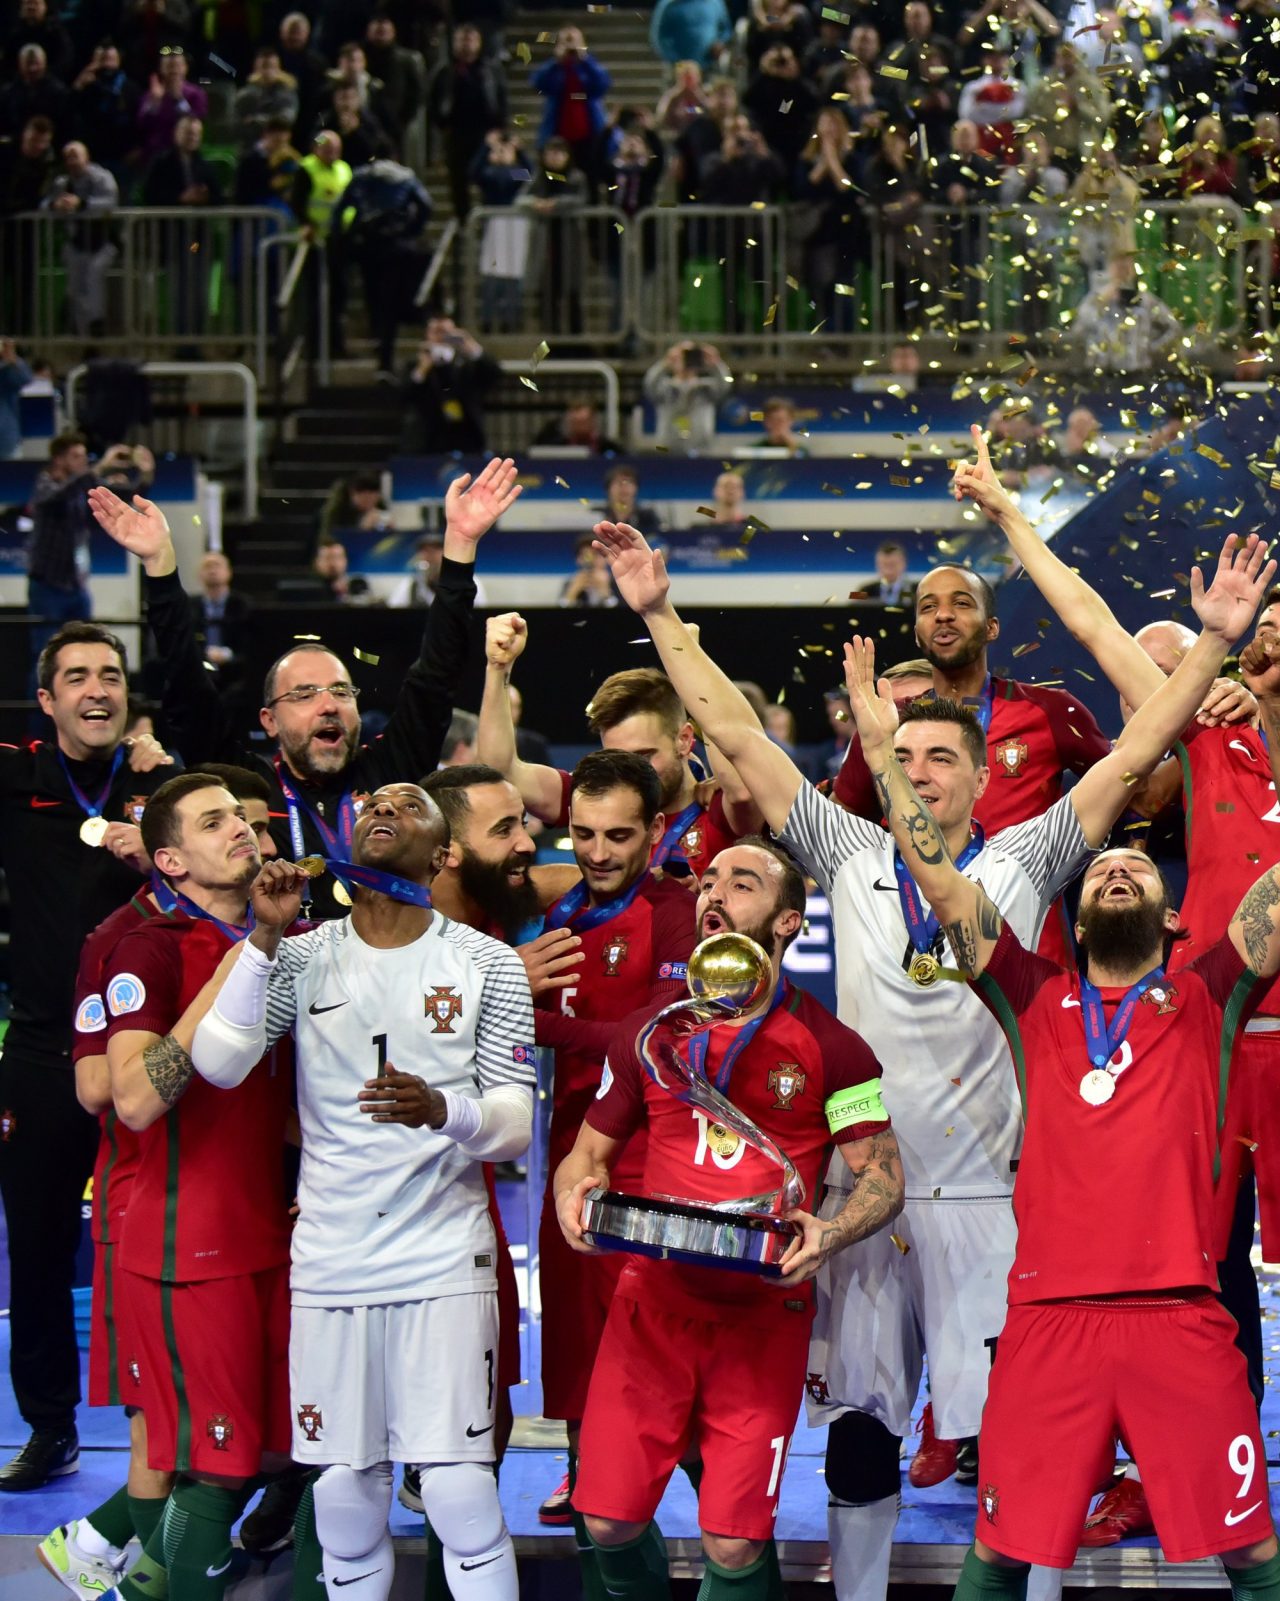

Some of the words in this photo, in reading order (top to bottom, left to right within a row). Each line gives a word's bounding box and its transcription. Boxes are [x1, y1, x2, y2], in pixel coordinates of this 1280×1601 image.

[295, 838, 303, 856] UEFA
[372, 1033, 388, 1091] 1
[829, 1100, 871, 1120] RESPECT
[485, 1349, 494, 1409] 1
[1228, 1434, 1256, 1499] 9
